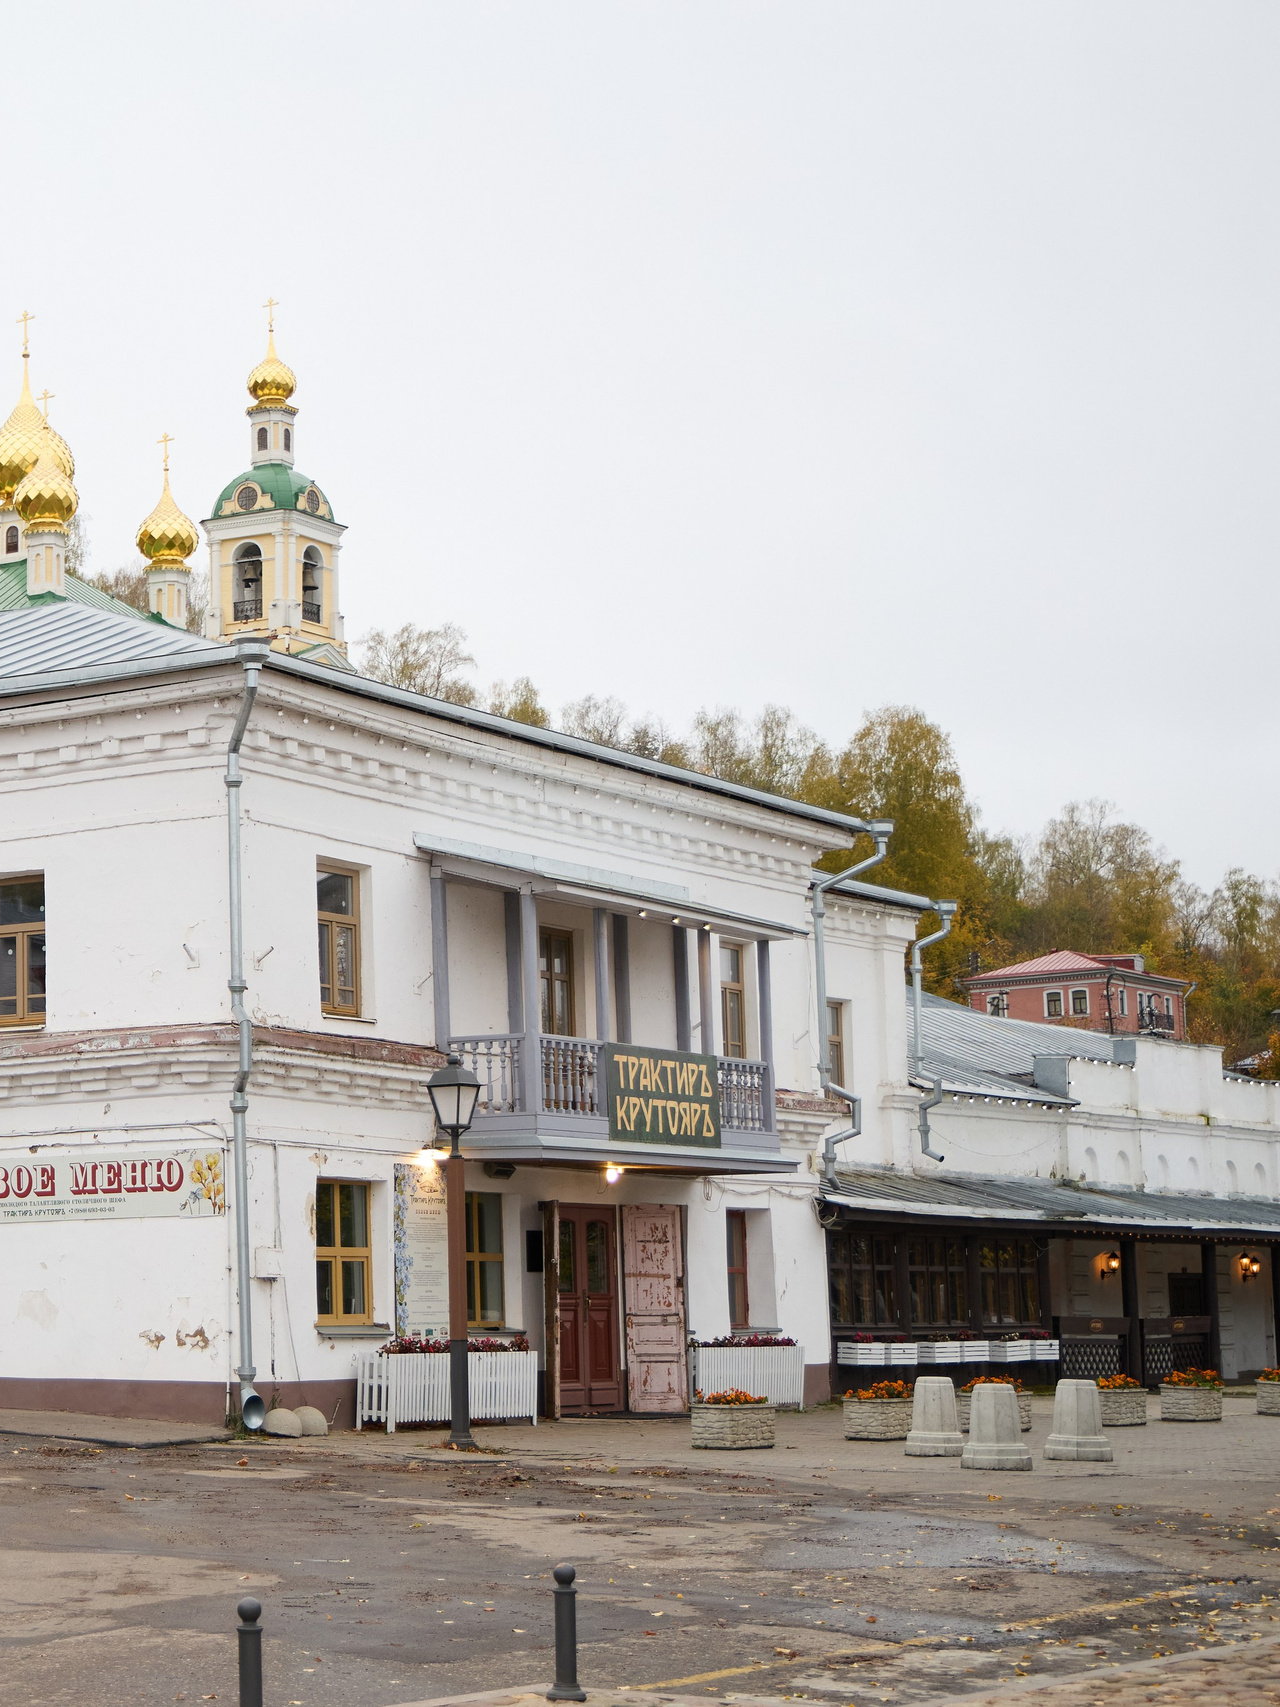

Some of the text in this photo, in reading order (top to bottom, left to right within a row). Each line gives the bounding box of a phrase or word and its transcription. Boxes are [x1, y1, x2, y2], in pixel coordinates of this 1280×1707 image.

[613, 1054, 713, 1098] ТРАКТИРЪ
[615, 1095, 715, 1138] КРУТОЯРЪ
[69, 1156, 185, 1196] МЕНЮ
[3, 1209, 33, 1218] ТРАКТИРЪ
[34, 1208, 65, 1216] КРУТОЯРЪ
